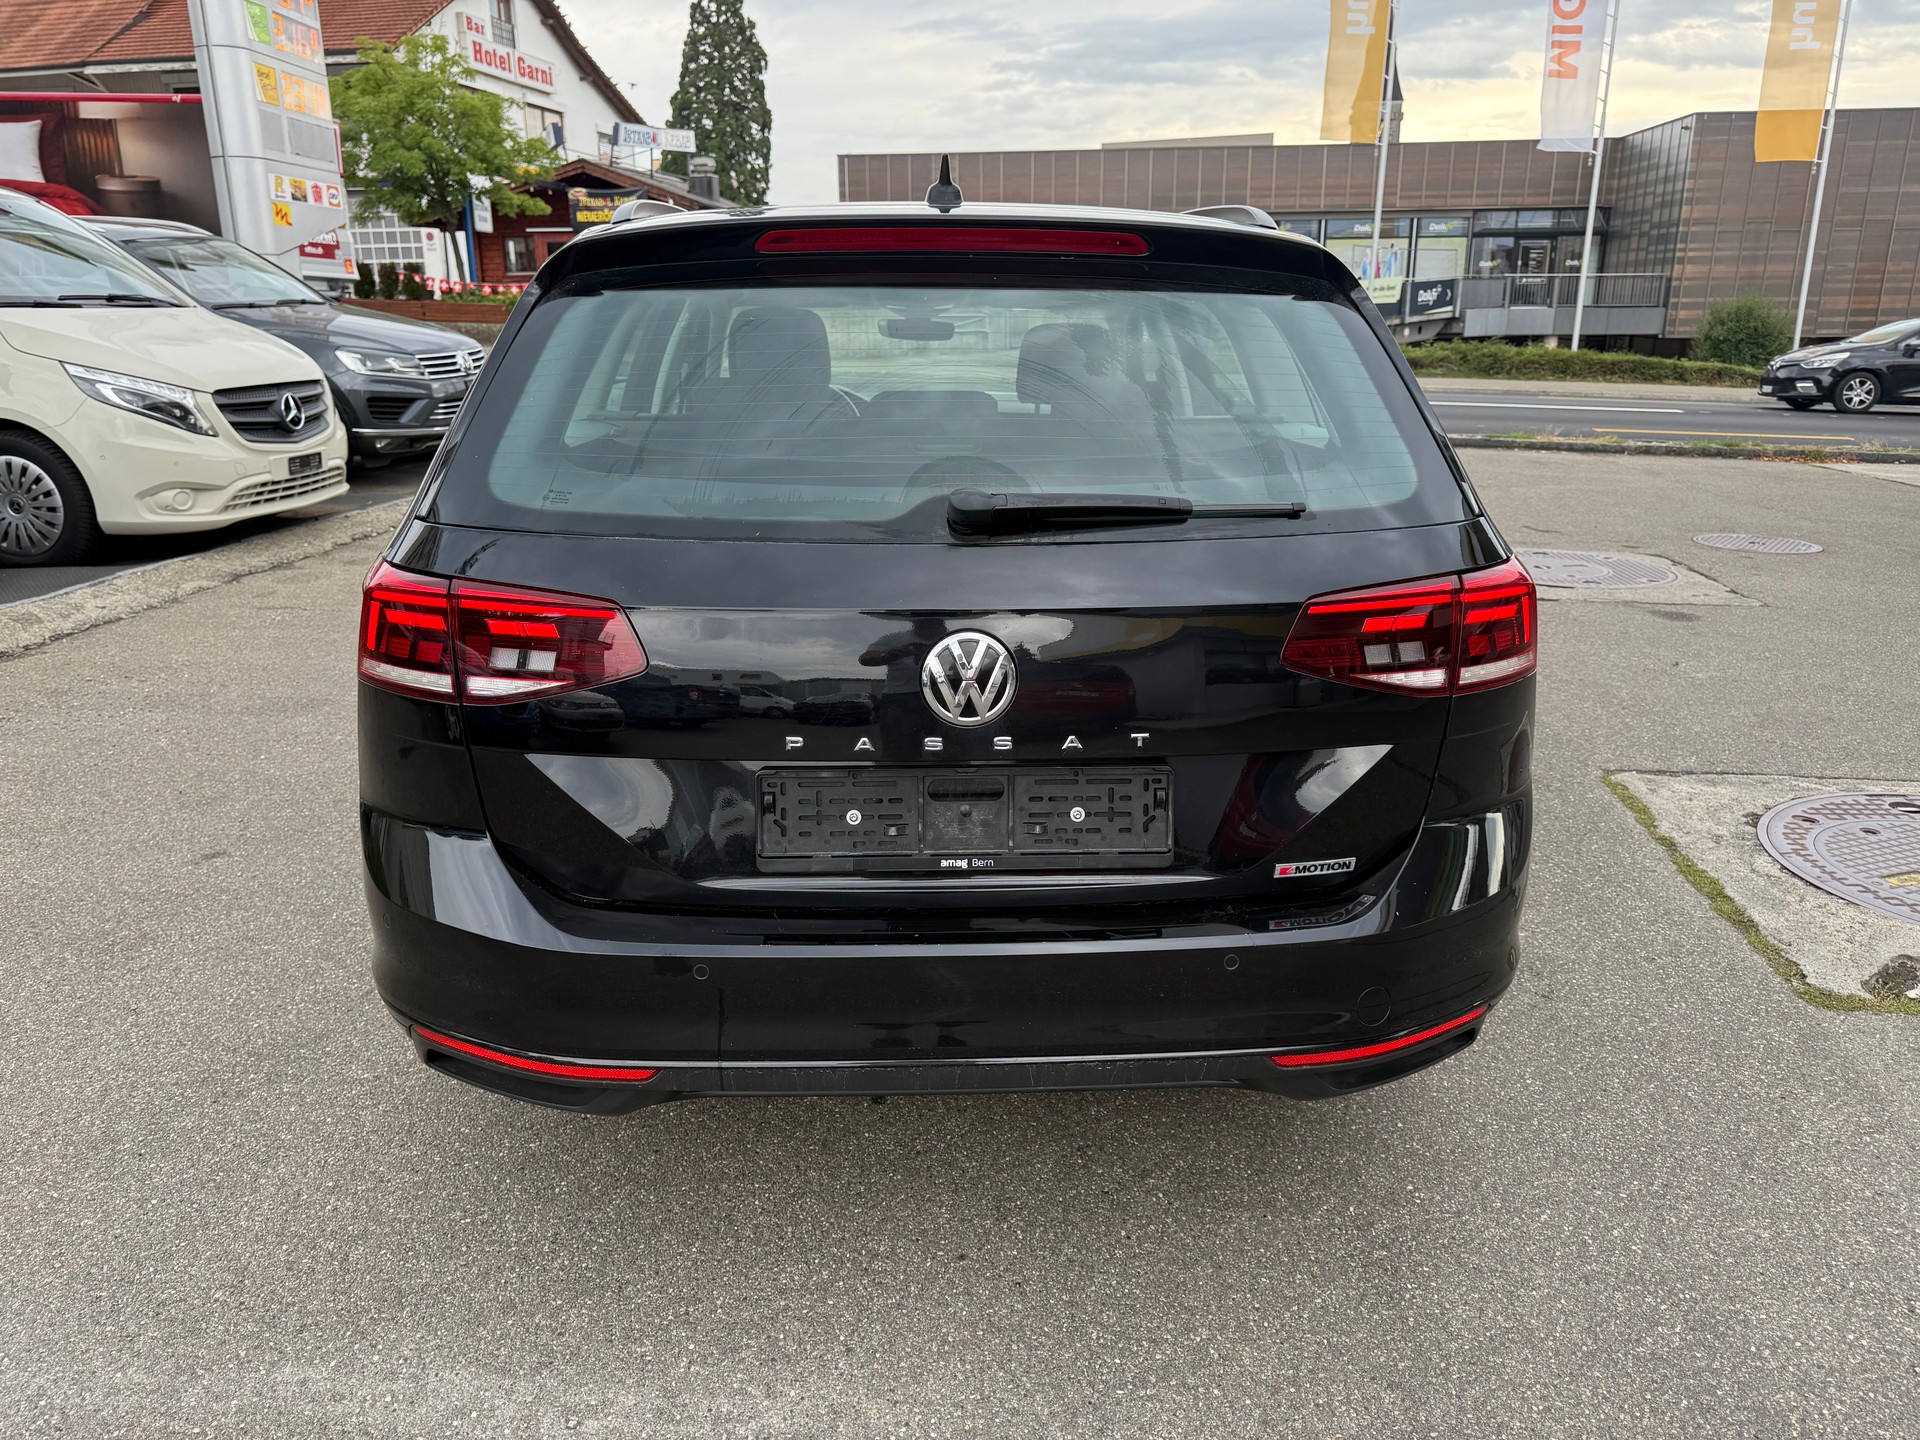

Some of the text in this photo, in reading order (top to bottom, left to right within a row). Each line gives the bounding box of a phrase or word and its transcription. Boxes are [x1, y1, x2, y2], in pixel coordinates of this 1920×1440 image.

[465, 15, 485, 36] Bar
[472, 40, 554, 87] Hotel Garni
[785, 732, 1150, 751] PASSAT
[940, 858, 994, 869] amag Bern
